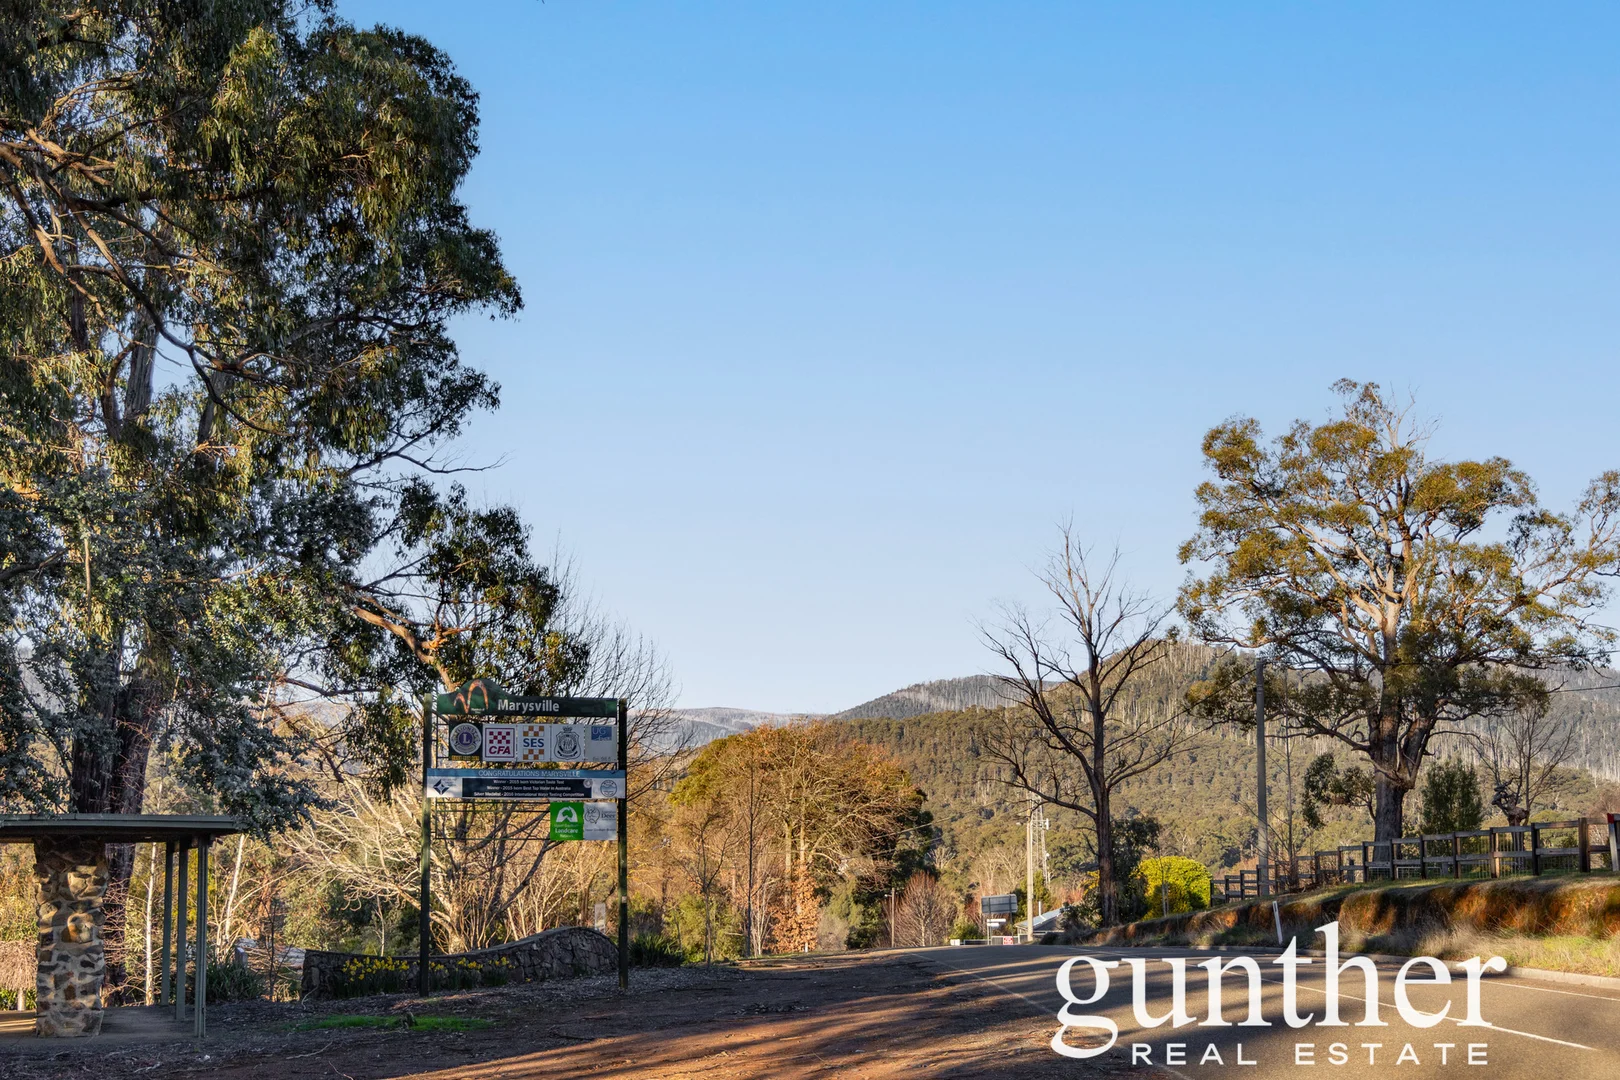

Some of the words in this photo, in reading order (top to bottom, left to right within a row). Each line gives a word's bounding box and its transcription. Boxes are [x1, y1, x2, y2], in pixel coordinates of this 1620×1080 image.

[497, 699, 560, 714] Marysville
[592, 726, 606, 735] UG
[462, 733, 471, 744] L
[523, 738, 545, 748] SES
[489, 746, 511, 755] CFA
